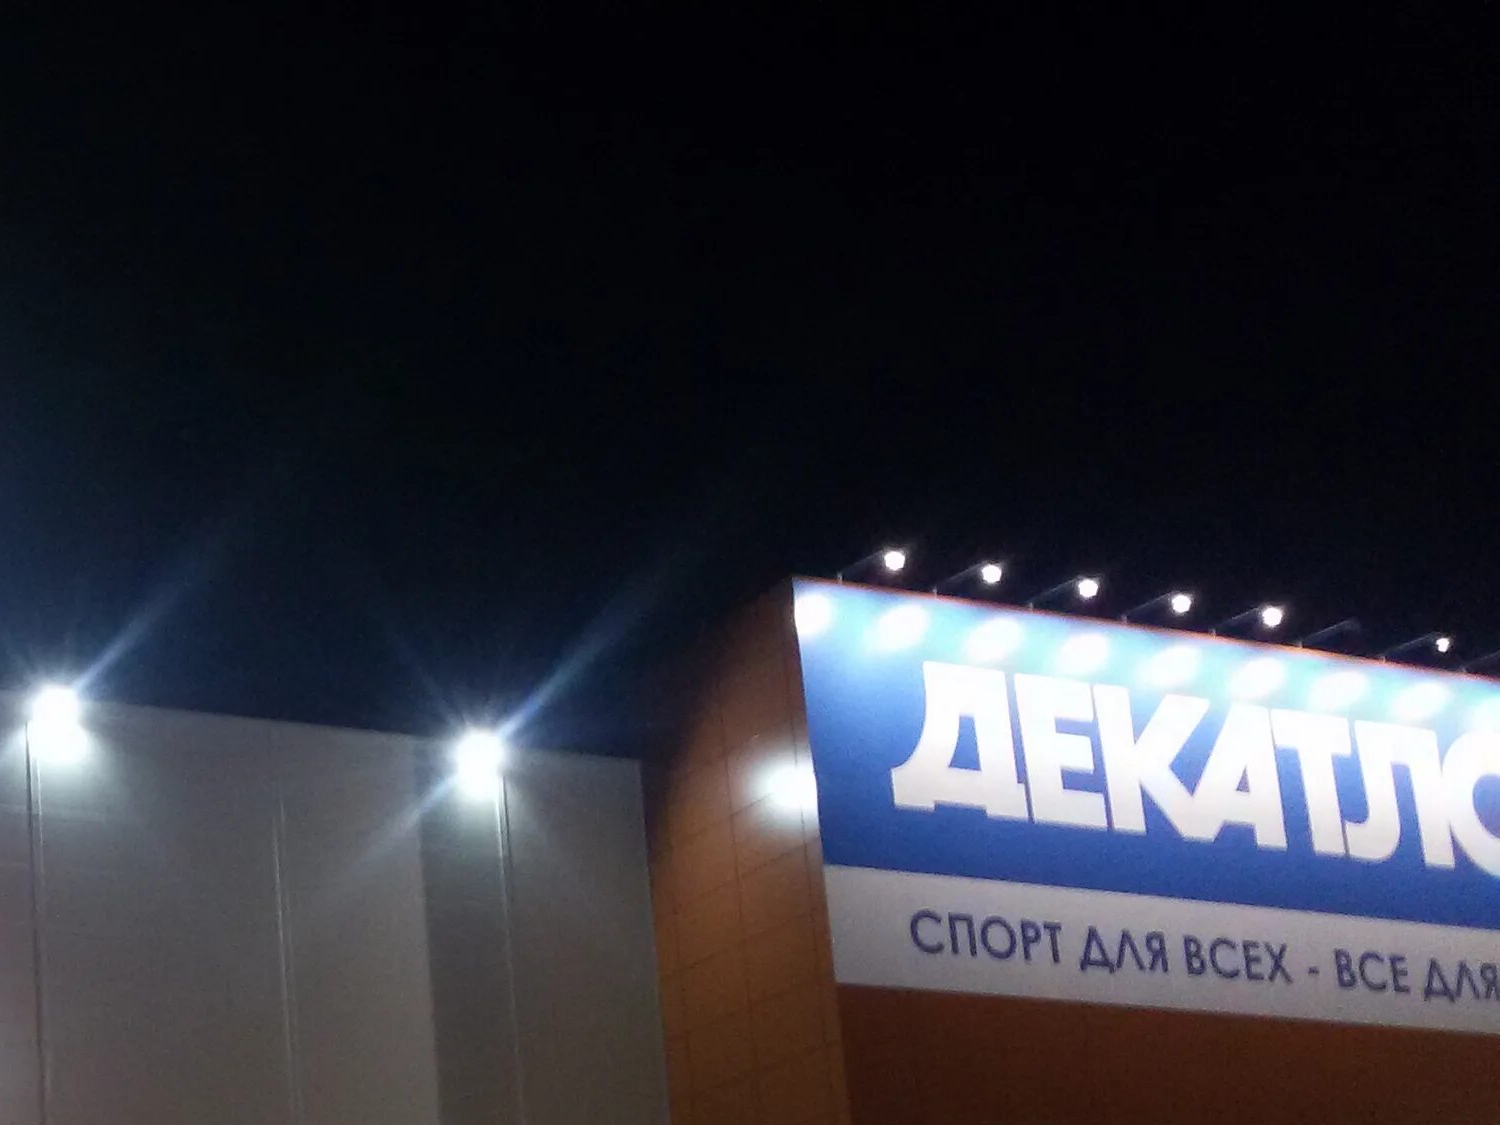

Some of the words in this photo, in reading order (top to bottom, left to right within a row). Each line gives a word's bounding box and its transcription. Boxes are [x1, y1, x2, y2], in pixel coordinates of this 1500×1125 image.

[909, 909, 1063, 965] СПОРТ
[1079, 925, 1169, 975] ДЛЯ
[1183, 933, 1293, 985] ВСЕХ
[1333, 947, 1412, 994] ВСЕ
[1422, 956, 1500, 1004] ДЛЯ
